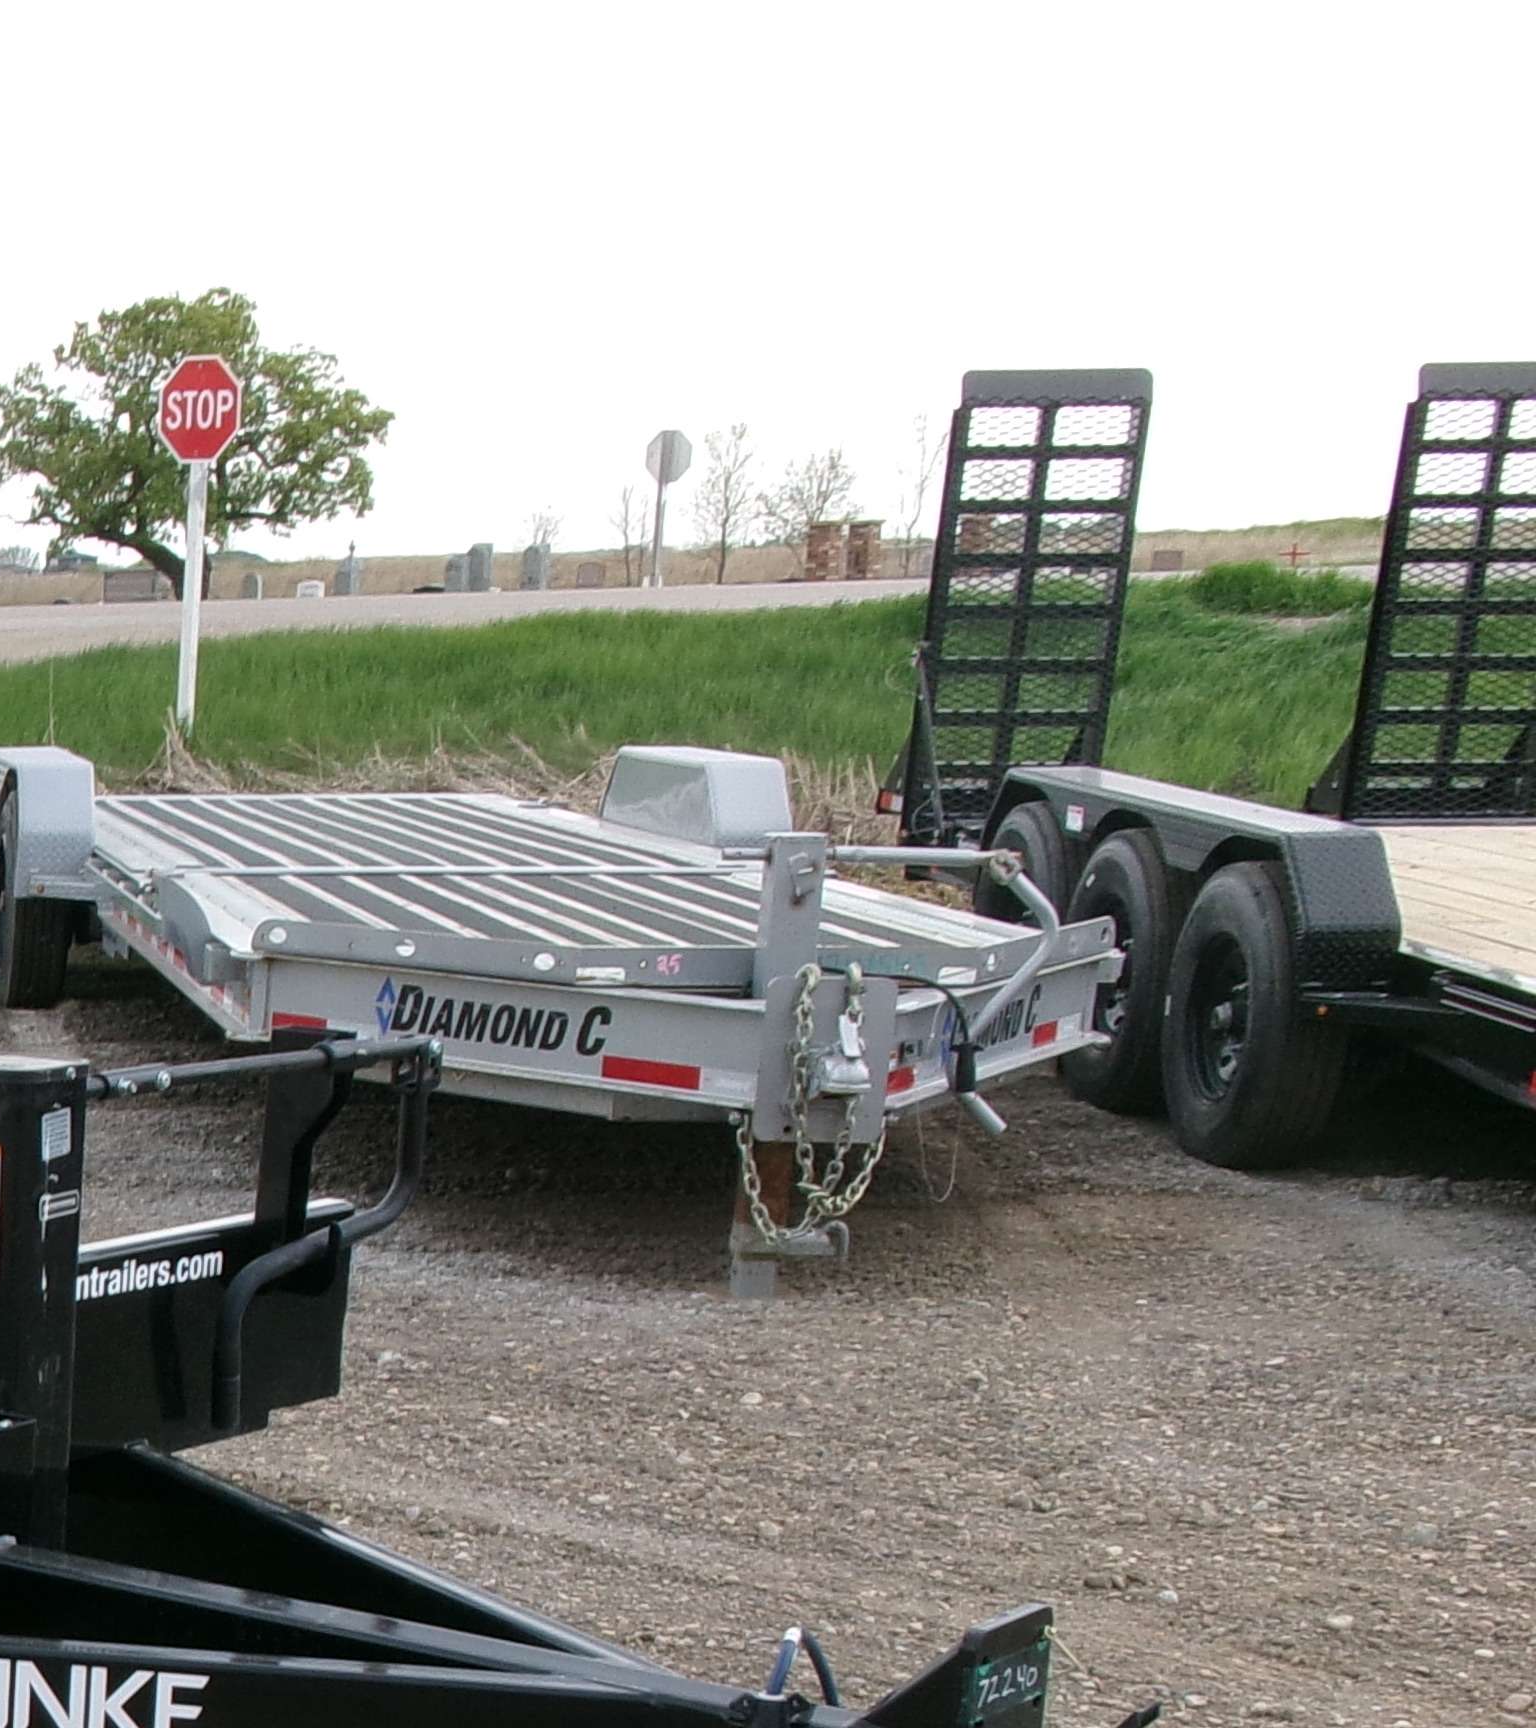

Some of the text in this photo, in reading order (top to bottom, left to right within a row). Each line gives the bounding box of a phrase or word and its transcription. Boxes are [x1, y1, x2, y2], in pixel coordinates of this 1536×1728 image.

[166, 388, 234, 430] STOP
[391, 984, 612, 1056] DIAMOND C
[75, 1250, 224, 1301] ntrailers.com
